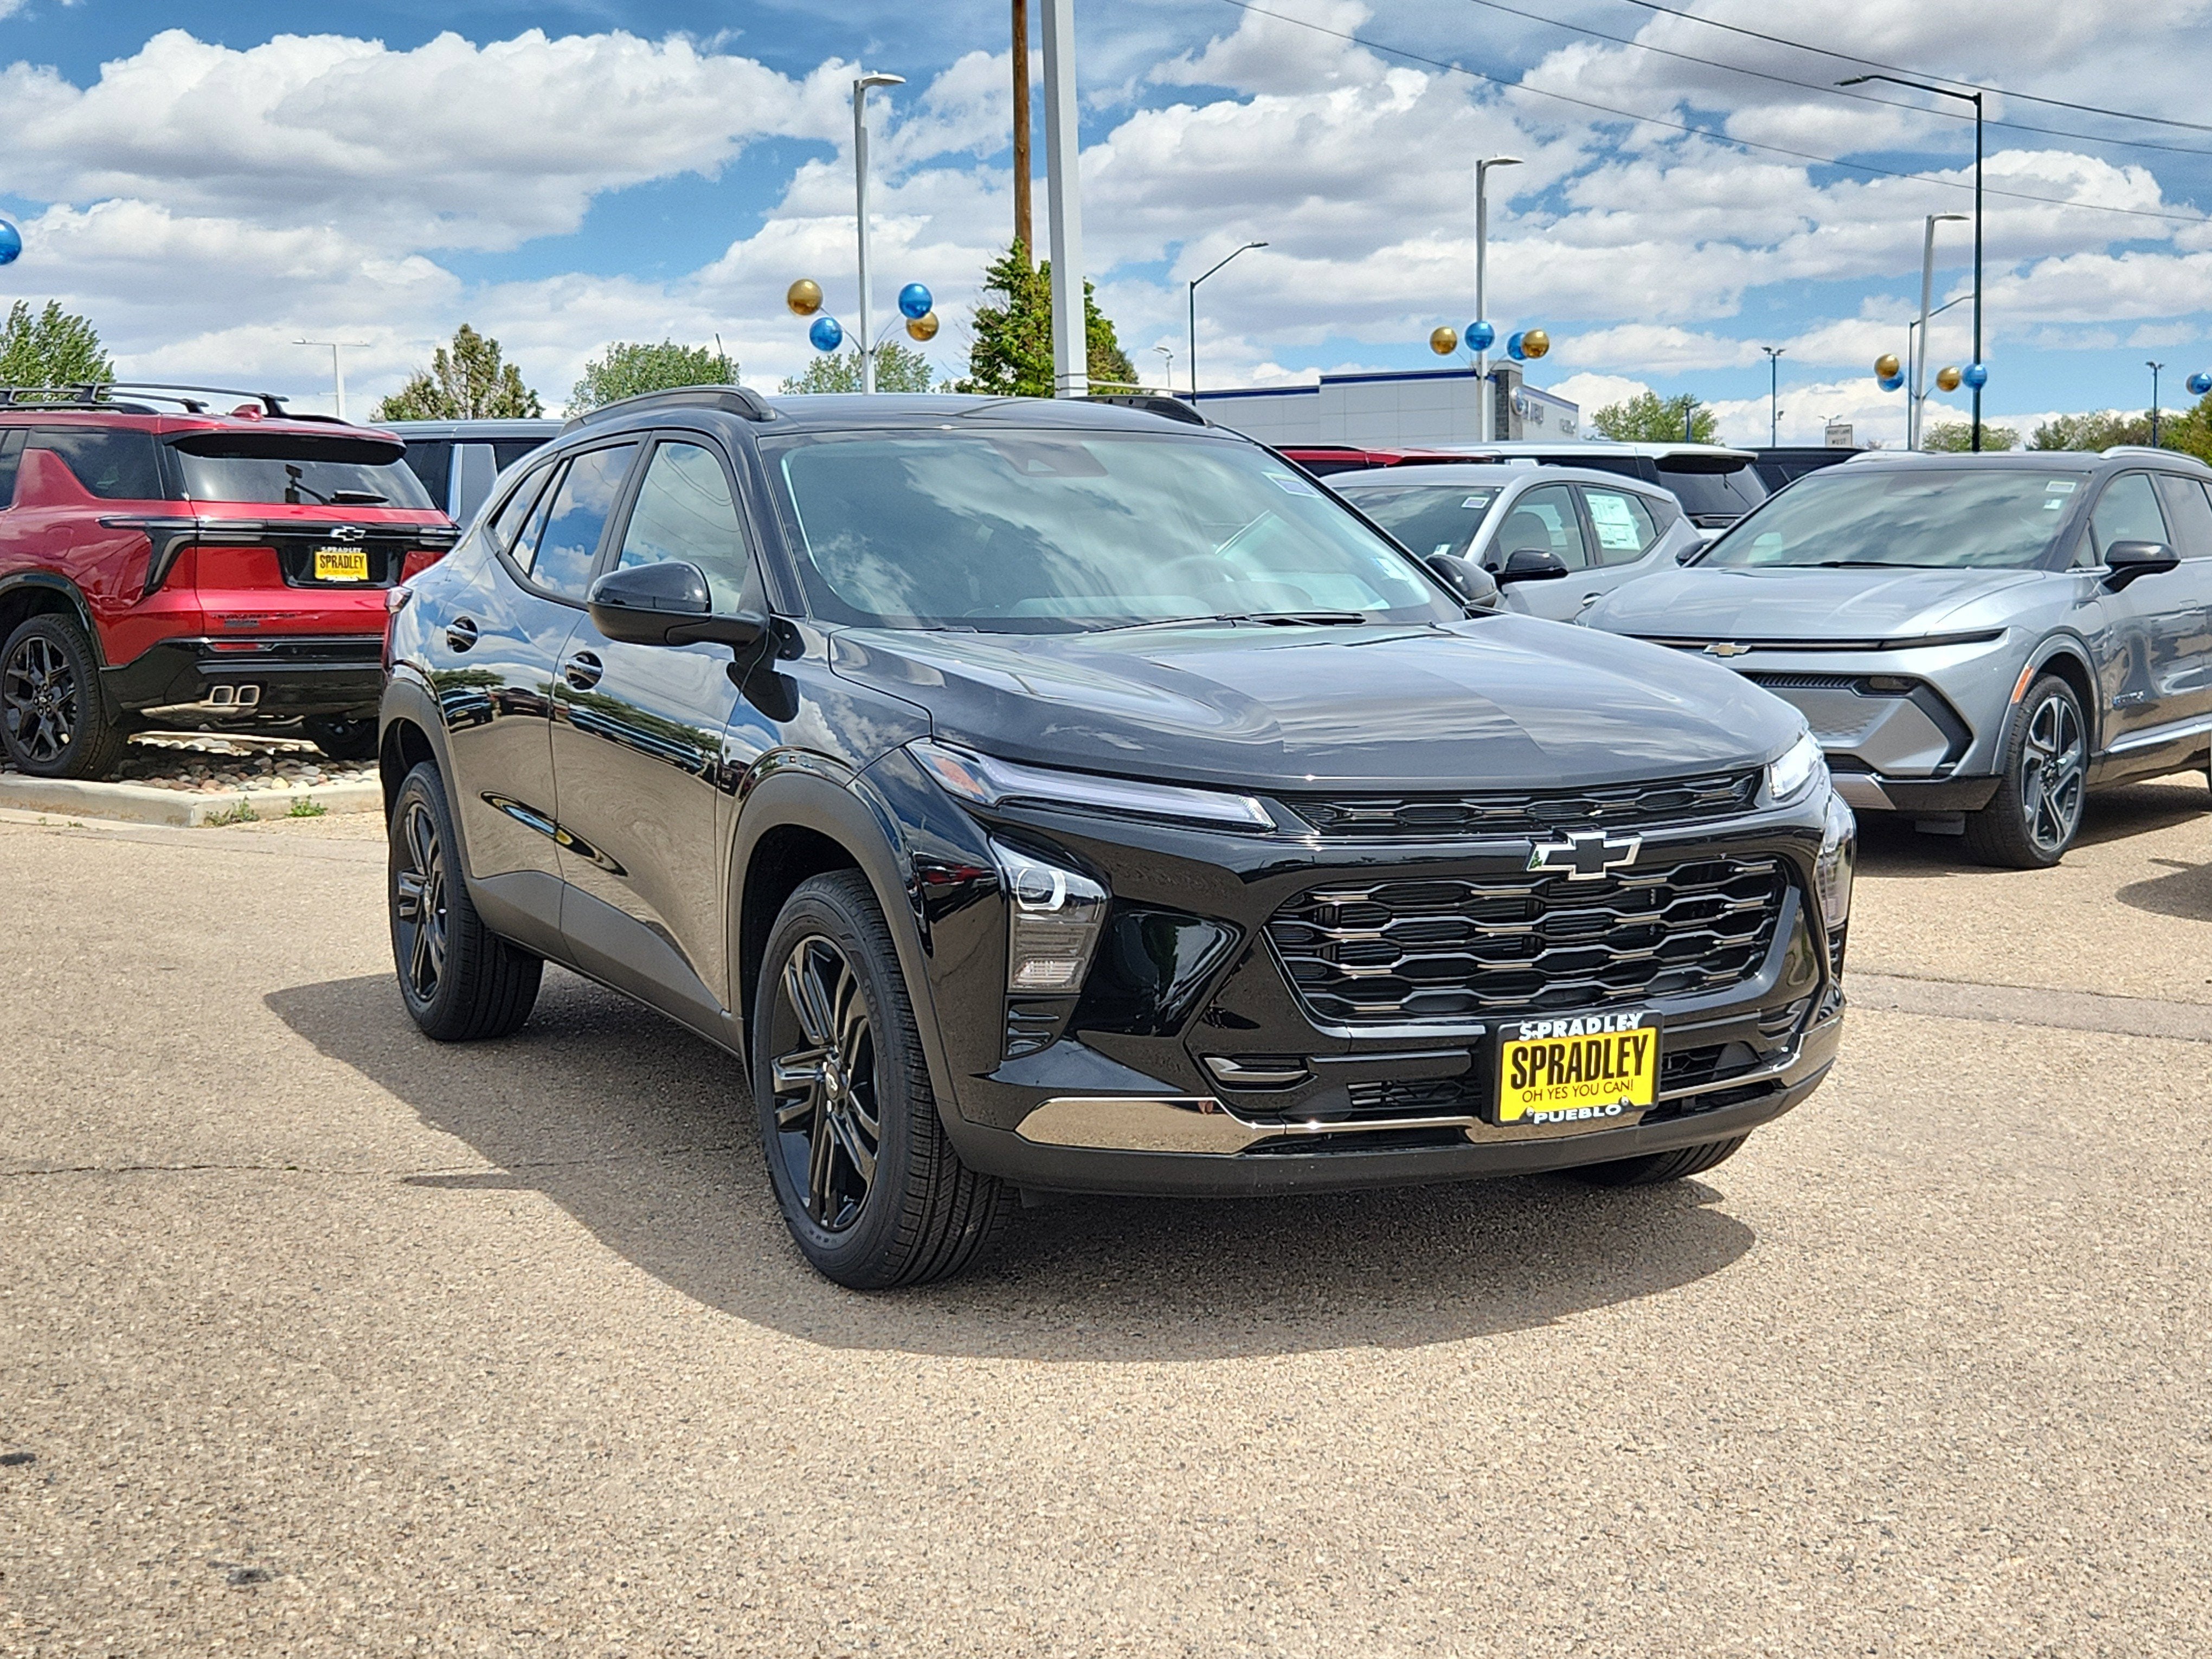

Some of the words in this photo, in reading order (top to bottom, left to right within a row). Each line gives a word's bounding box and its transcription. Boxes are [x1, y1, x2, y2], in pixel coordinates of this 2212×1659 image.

[319, 555, 364, 569] SPRADLEY
[1519, 1013, 1643, 1041] SPRADLEY
[1510, 1034, 1649, 1090] SPRADLEY
[1522, 1089, 1542, 1103] OH
[1548, 1086, 1568, 1099] YES
[1572, 1083, 1599, 1097] YOU
[1603, 1079, 1634, 1094] CAN!
[1534, 1104, 1622, 1124] PUEBLO
